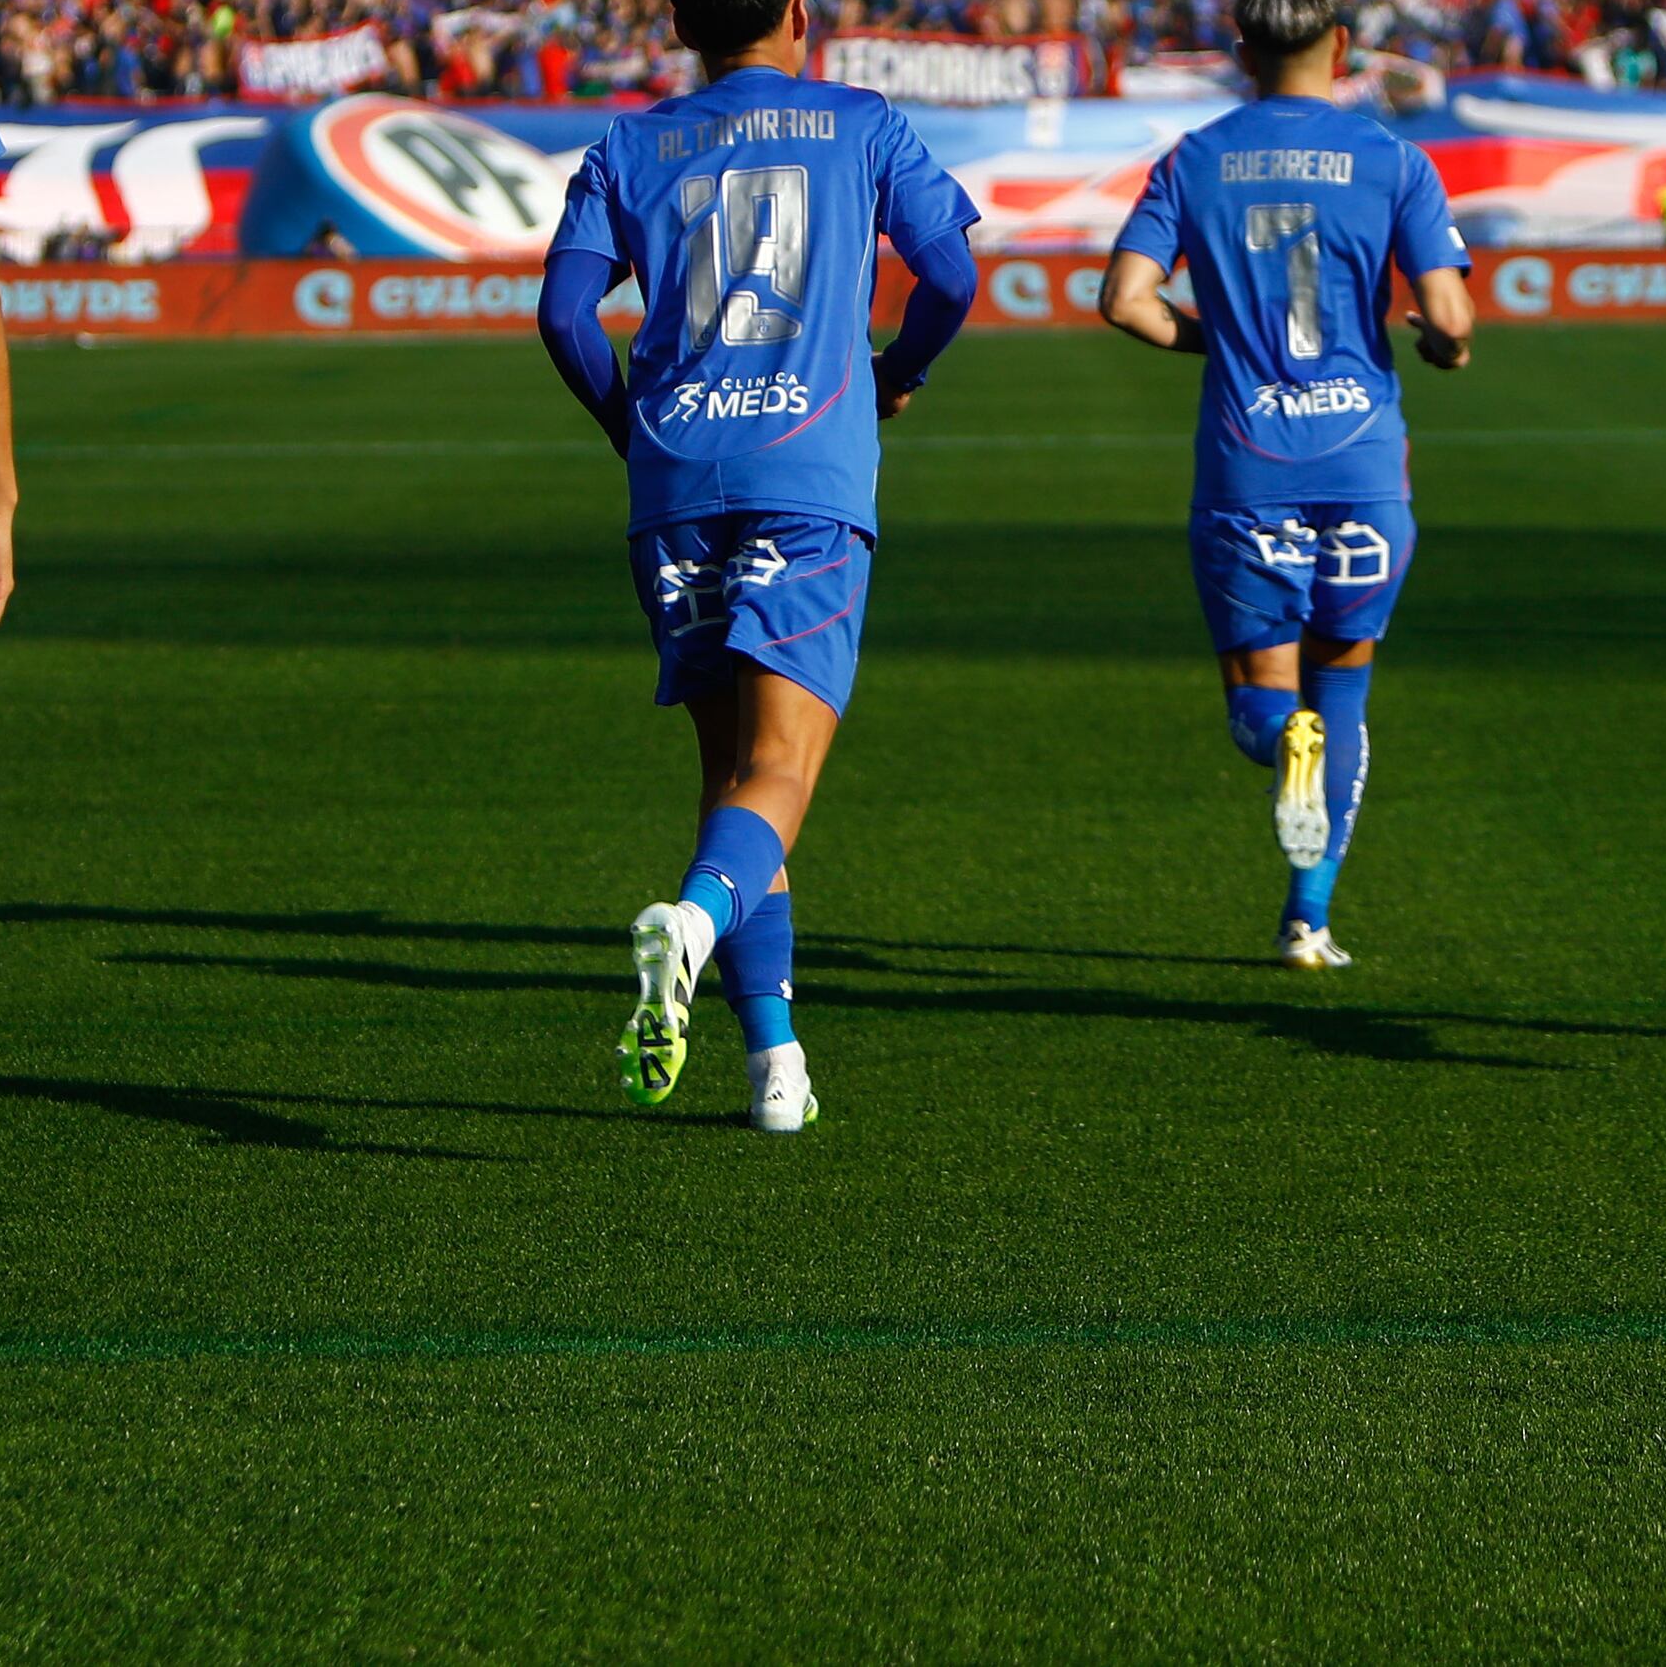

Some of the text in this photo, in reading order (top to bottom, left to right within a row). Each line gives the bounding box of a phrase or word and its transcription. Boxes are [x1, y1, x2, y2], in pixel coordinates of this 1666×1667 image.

[658, 108, 836, 162] ALTAMIRANO
[1221, 149, 1353, 184] GUERRERO
[680, 165, 809, 351] 19
[1245, 203, 1322, 360] 7
[721, 371, 799, 390] CLINICA
[706, 385, 810, 420] MEDS
[1282, 386, 1371, 418] MEDS
